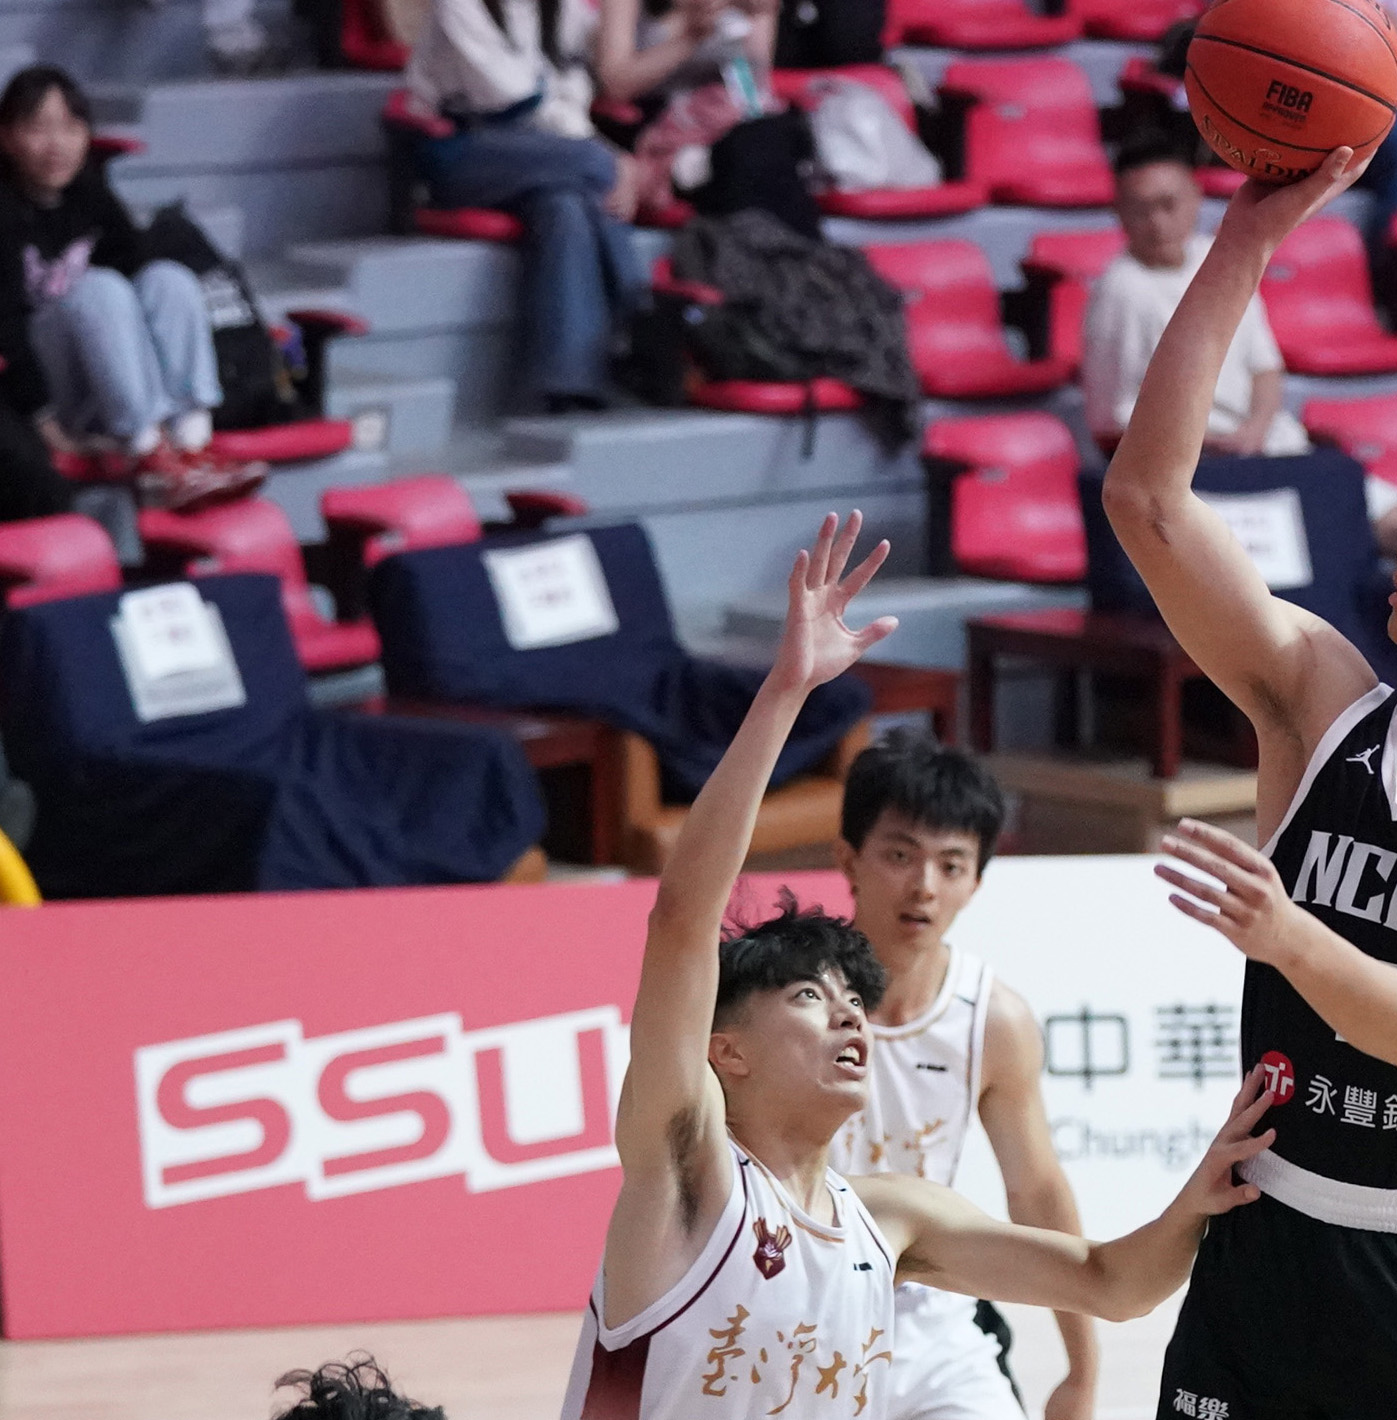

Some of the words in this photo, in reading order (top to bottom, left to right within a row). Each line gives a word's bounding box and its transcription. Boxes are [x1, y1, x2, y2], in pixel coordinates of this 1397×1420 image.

[1265, 79, 1314, 113] FIBA
[1043, 1003, 1237, 1092] 中華
[156, 1026, 613, 1186] SSU
